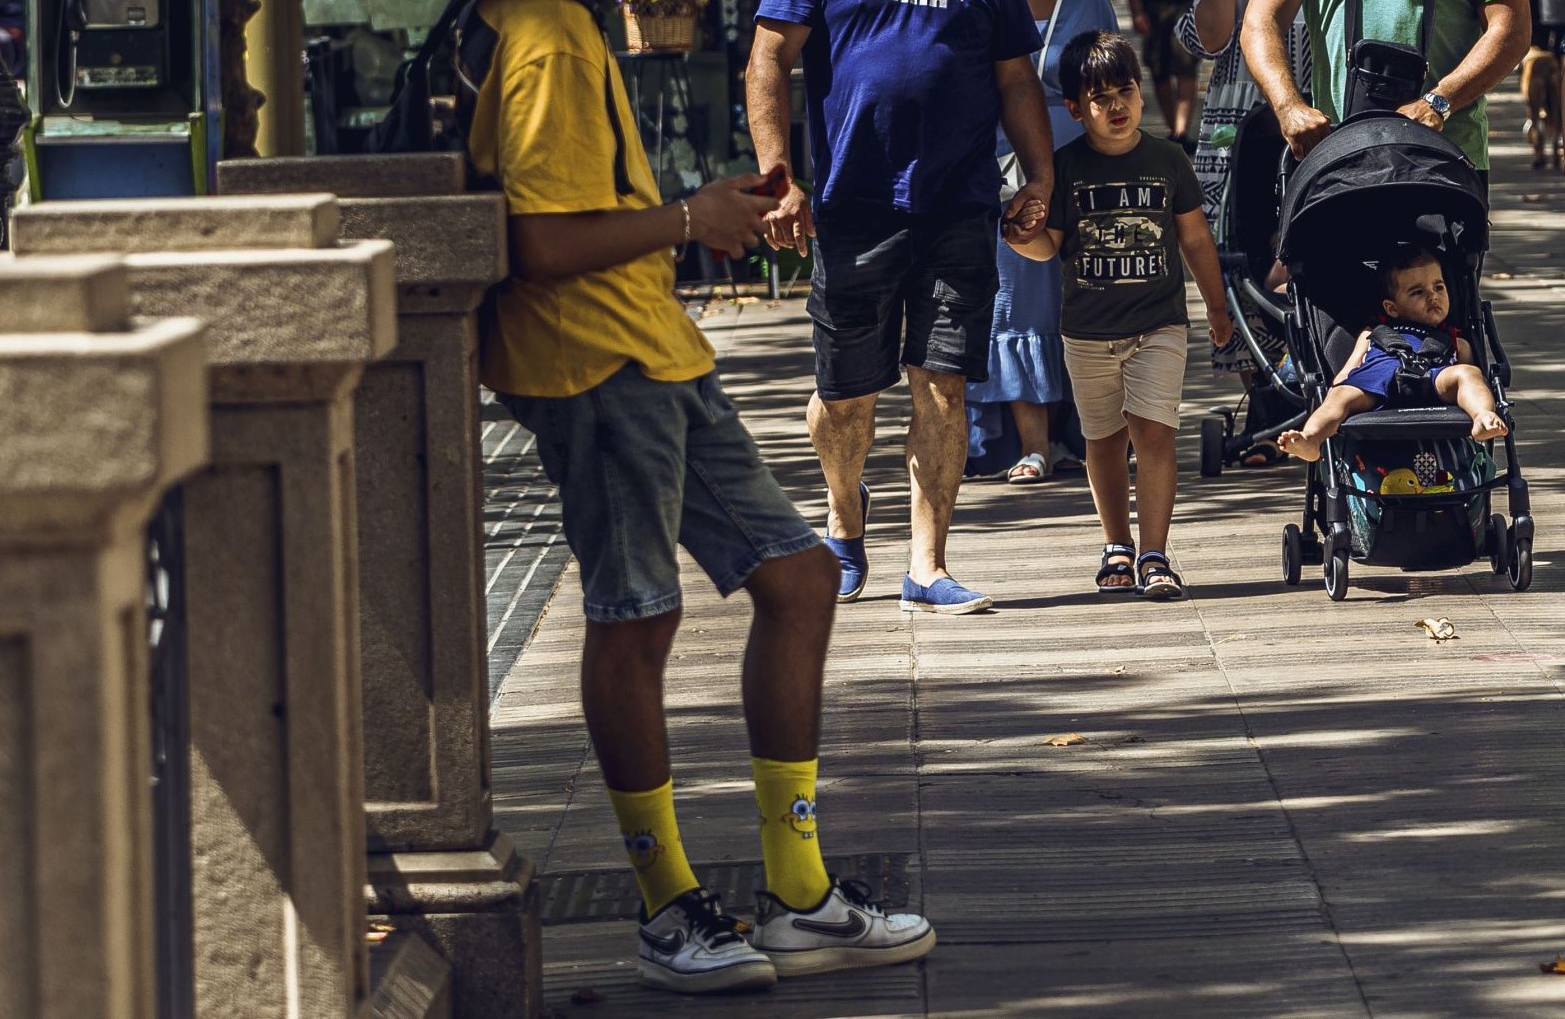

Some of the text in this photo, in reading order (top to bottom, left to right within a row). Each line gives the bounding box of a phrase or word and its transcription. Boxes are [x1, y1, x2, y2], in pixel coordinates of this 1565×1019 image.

[1089, 187, 1151, 210] I AM
[1082, 255, 1157, 277] FUTURE
